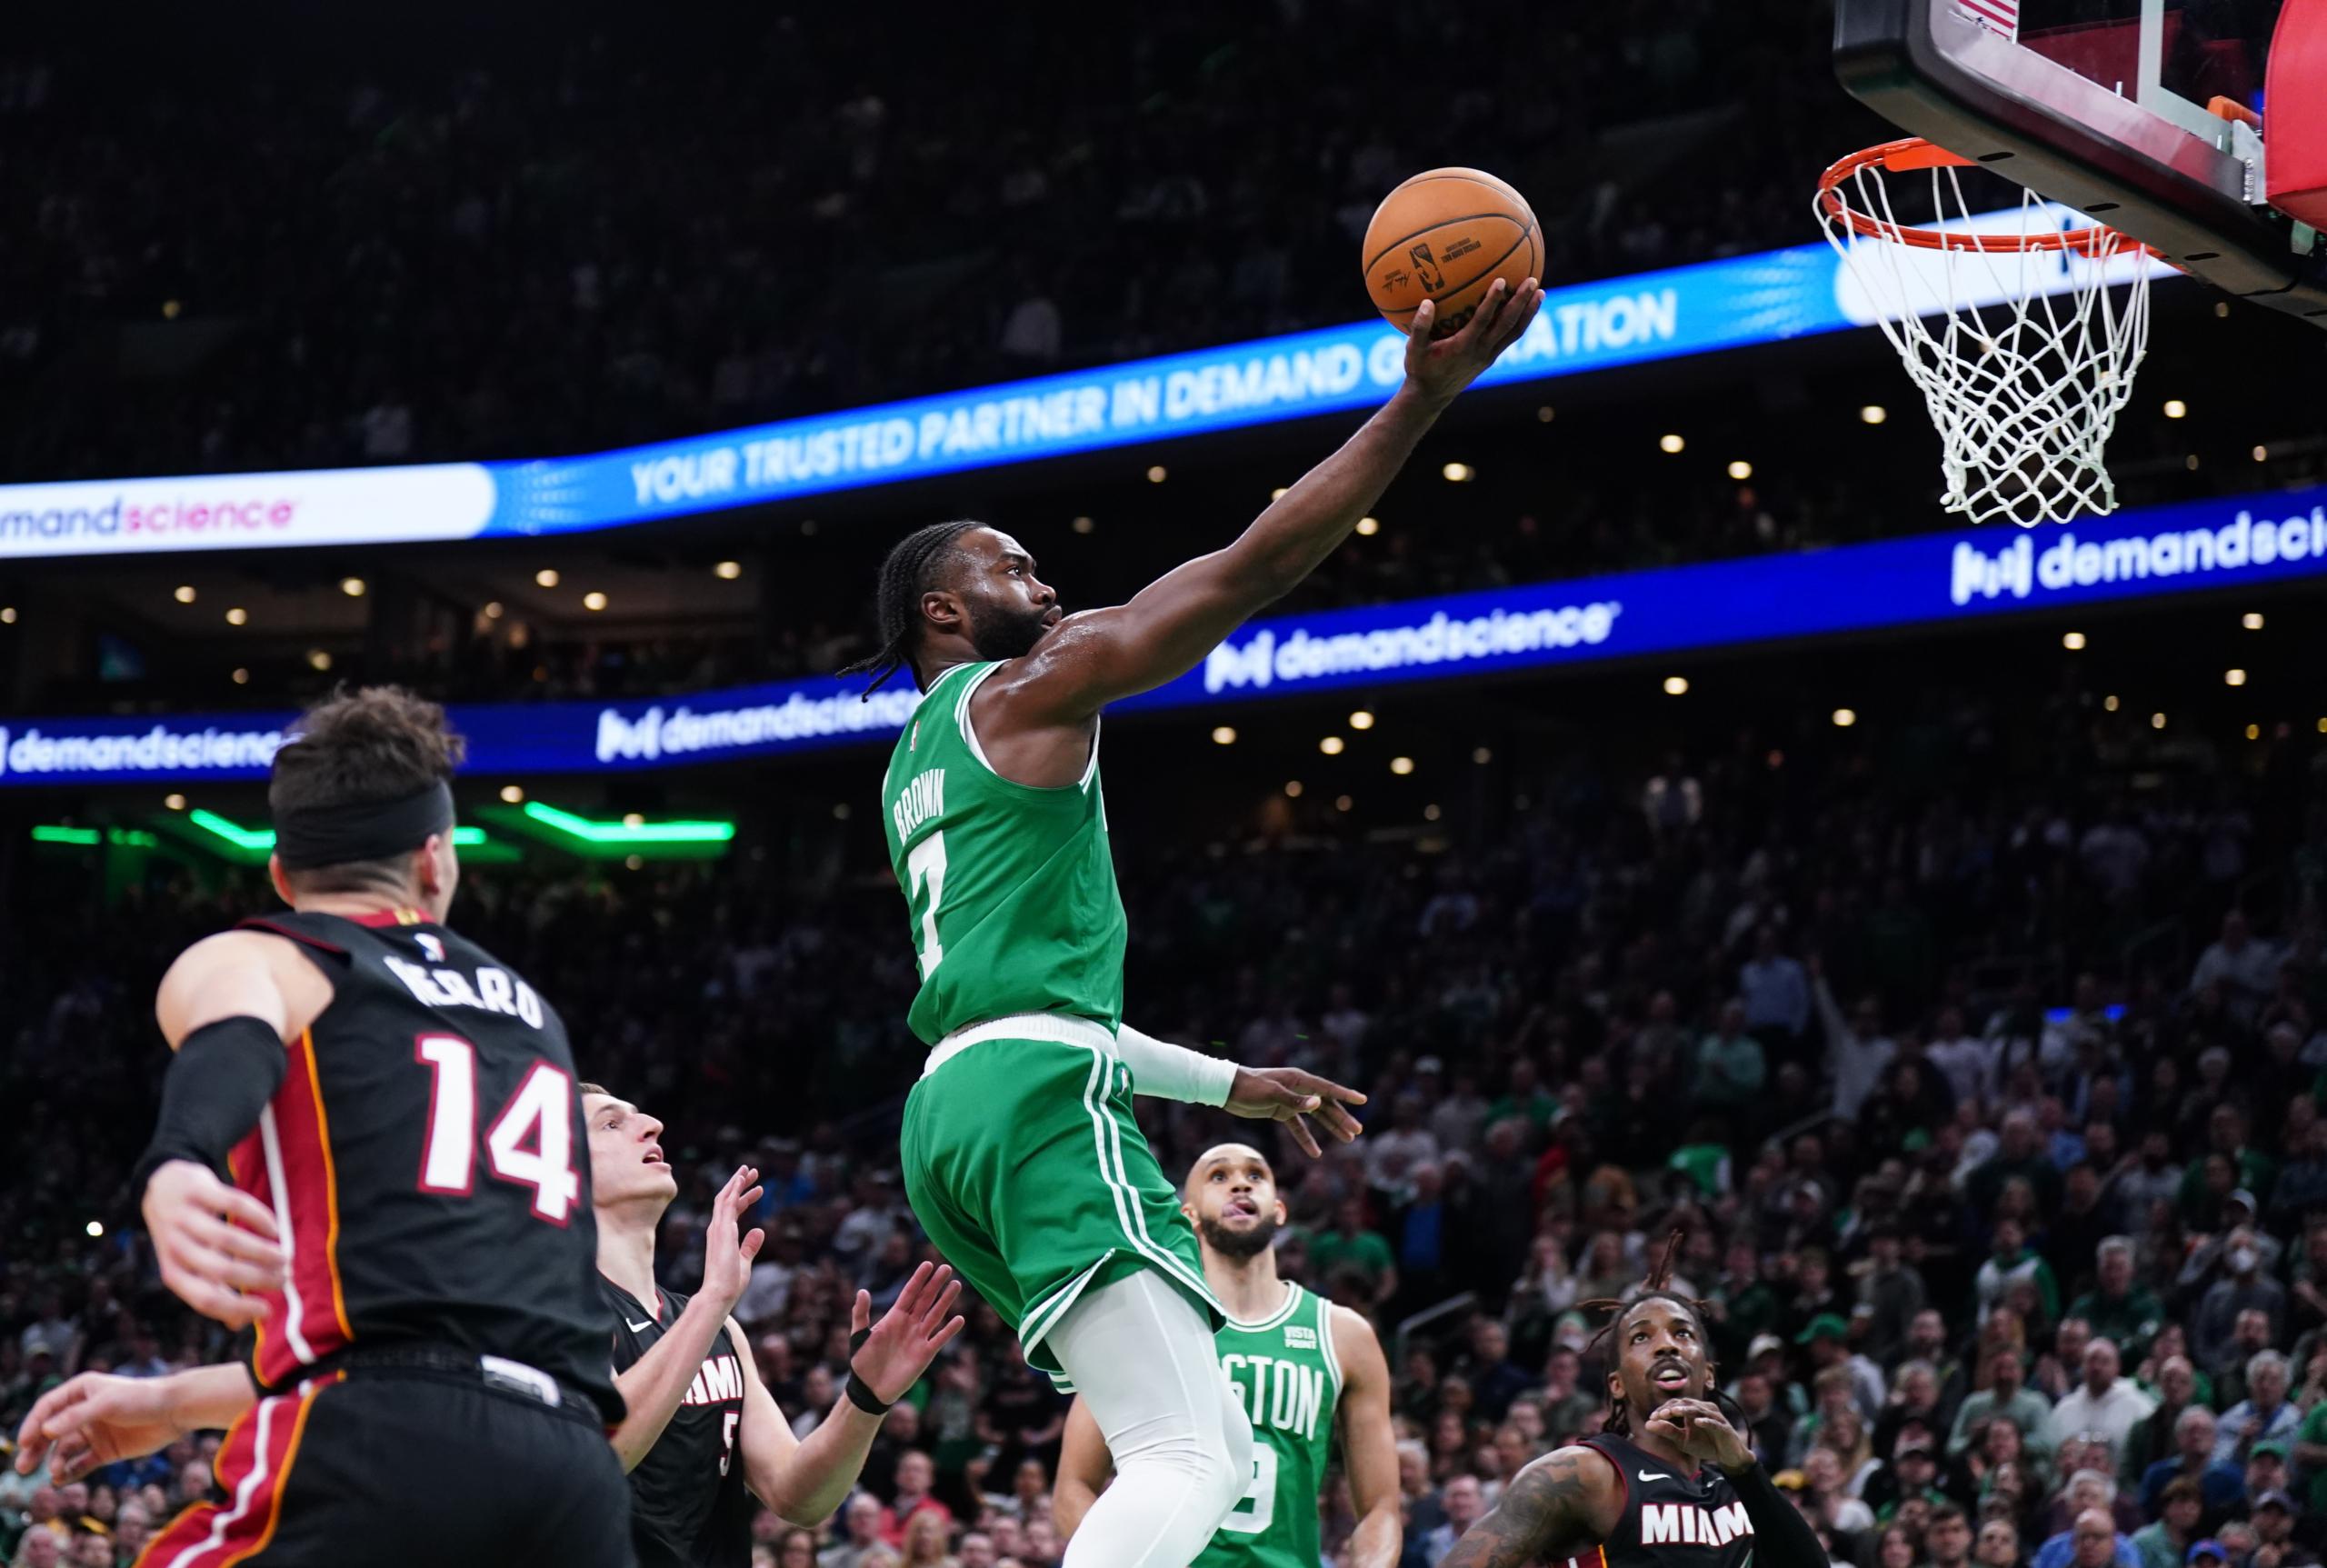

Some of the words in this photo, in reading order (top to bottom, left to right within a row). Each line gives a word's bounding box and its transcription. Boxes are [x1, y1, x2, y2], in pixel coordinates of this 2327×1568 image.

[631, 448, 737, 505] YOUR
[742, 417, 914, 488] TRUSTED
[918, 385, 1108, 458] PARTNER
[1111, 375, 1161, 425] IN
[1165, 342, 1363, 419] DEMAND
[1367, 287, 1676, 386] GATION
[1274, 602, 1613, 681] demandscience
[8, 724, 281, 773] demandscienc
[894, 769, 945, 846] BROWN
[908, 830, 947, 983] 7
[414, 1032, 582, 1228] 14
[681, 1355, 744, 1404] AMI
[1221, 1353, 1323, 1442] STON
[1642, 1501, 1755, 1546] MIAM
